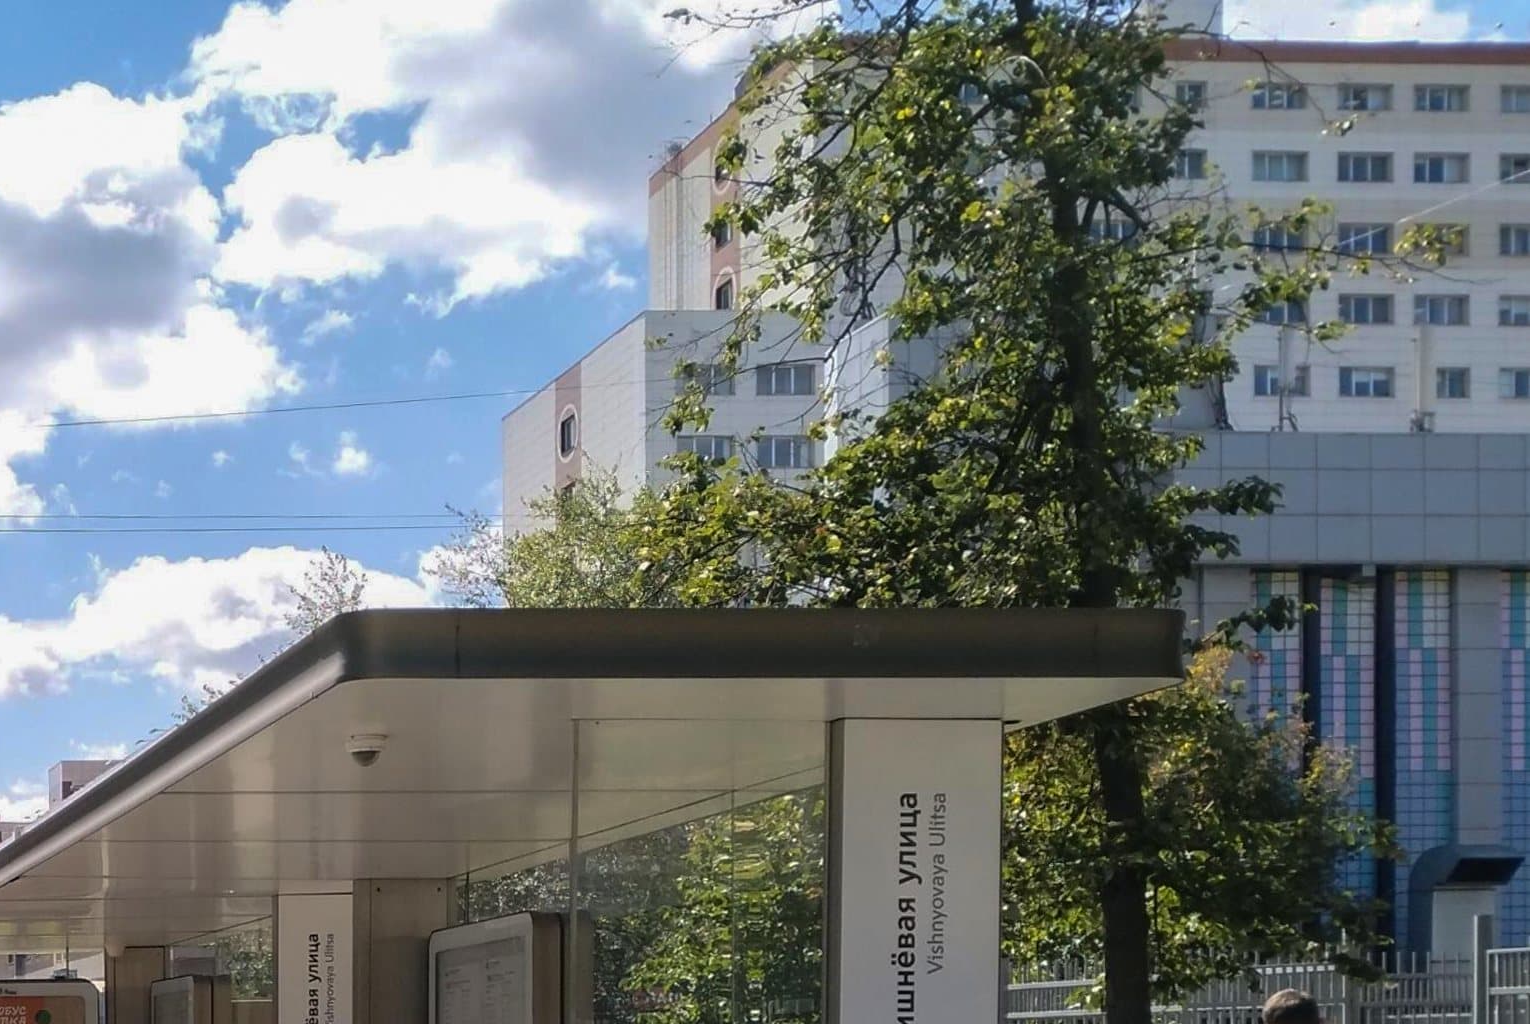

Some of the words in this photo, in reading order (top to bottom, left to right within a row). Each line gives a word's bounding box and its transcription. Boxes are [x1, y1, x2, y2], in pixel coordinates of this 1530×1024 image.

[899, 793, 922, 885] улица
[928, 793, 946, 847] Ulitsa
[926, 854, 948, 975] Vishnyovaya
[308, 934, 321, 983] улица
[325, 933, 335, 963] Ulitsa
